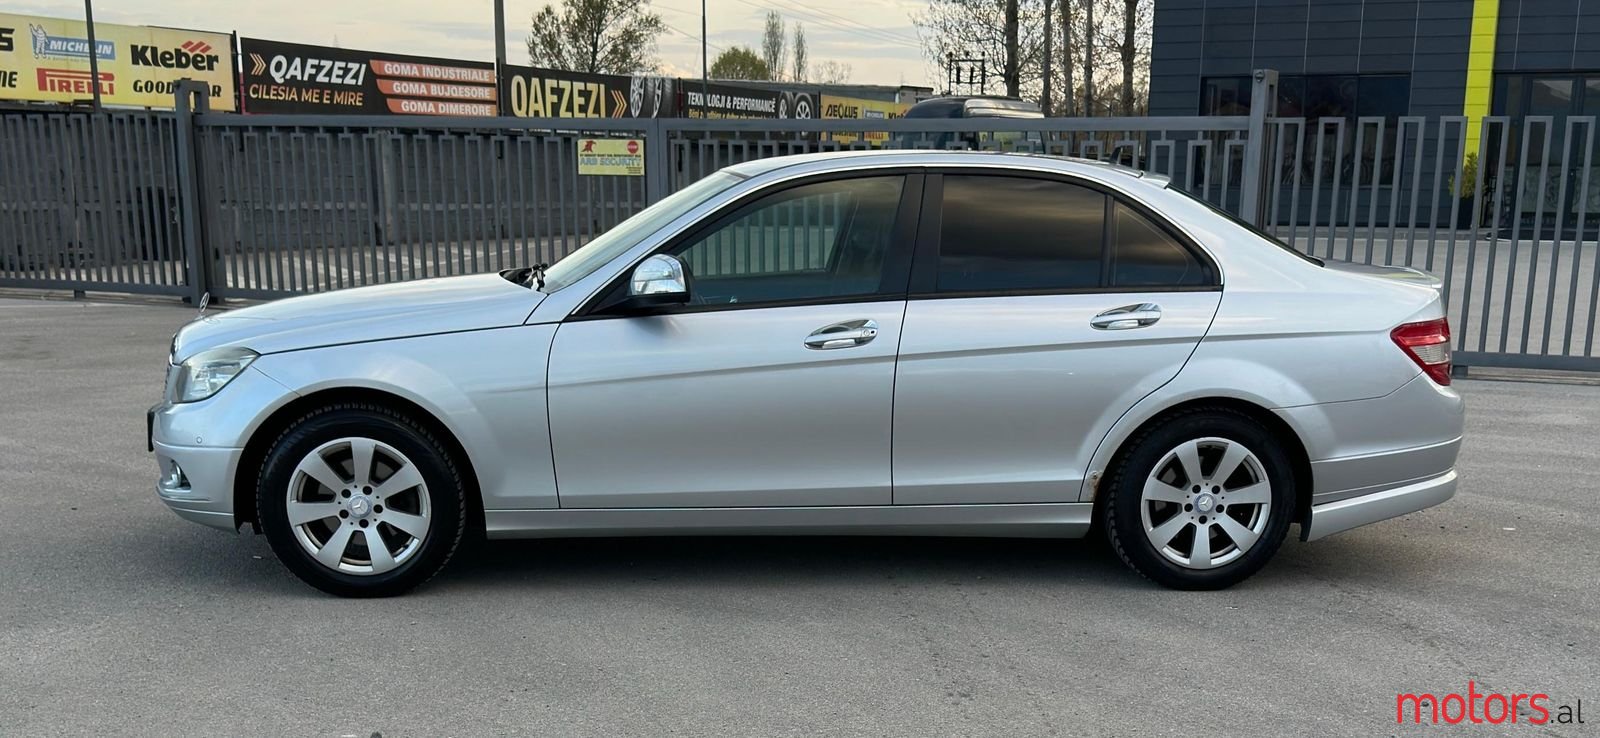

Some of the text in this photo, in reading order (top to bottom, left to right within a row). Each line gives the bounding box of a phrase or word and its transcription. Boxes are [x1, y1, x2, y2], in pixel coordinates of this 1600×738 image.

[130, 44, 219, 71] Kleber
[269, 55, 367, 86] QAFZEZI
[384, 63, 490, 82] GOMA INDUSTRIALE
[249, 83, 364, 106] CILESIA ME E MIRE
[392, 82, 491, 99] GOMA BUJQESORE
[510, 75, 606, 118] QAFZEZI
[401, 101, 491, 116] GOMA DIMERORE
[726, 96, 732, 109] &
